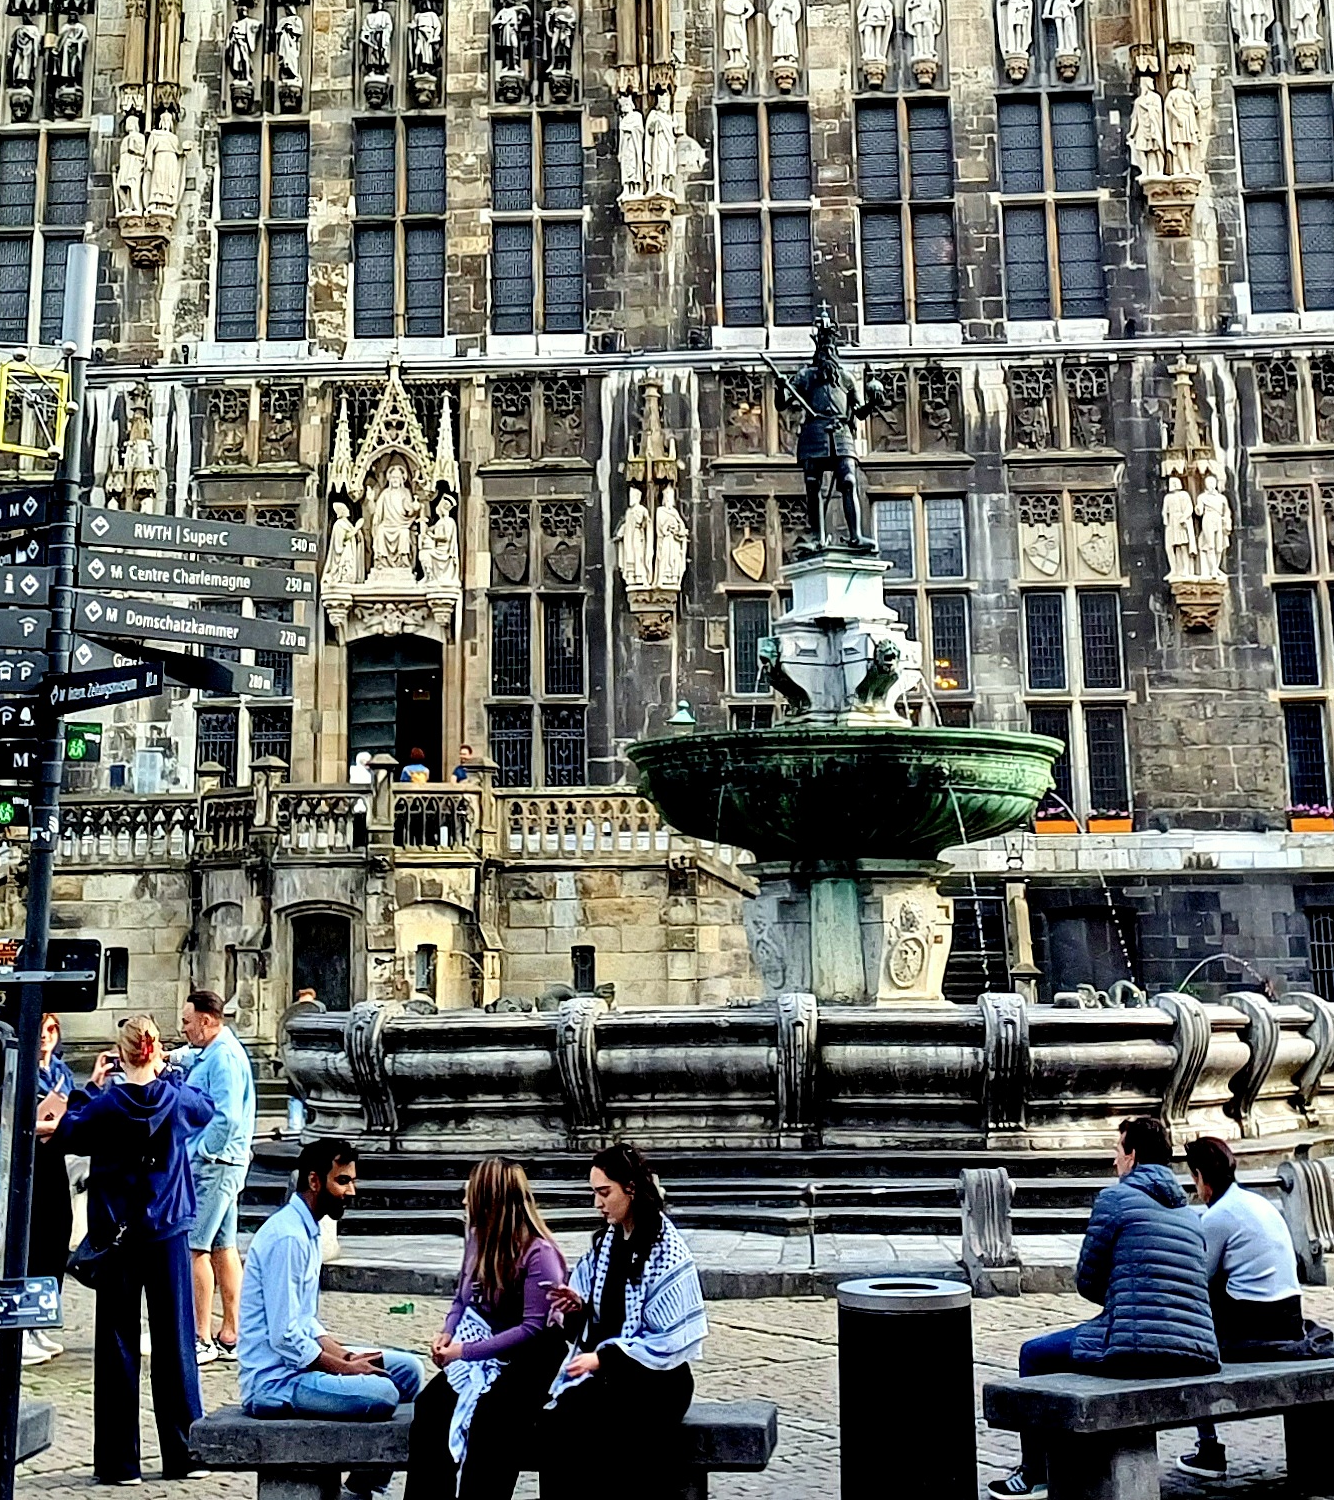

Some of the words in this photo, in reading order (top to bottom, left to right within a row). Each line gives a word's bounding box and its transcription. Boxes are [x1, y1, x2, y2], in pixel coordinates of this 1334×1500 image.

[9, 502, 20, 517] M
[134, 523, 172, 541] RWTH
[183, 530, 229, 547] SuperC
[291, 537, 308, 552] 540
[308, 542, 317, 553] m
[110, 565, 123, 579] M
[129, 565, 170, 583] Centre
[173, 568, 251, 591] Charlemagne
[285, 577, 302, 592] 250
[303, 581, 312, 592] m
[105, 607, 118, 622] M
[125, 610, 240, 639] Domschatzkammer
[279, 630, 297, 646] 220
[297, 636, 306, 647] m
[263, 679, 271, 690] m
